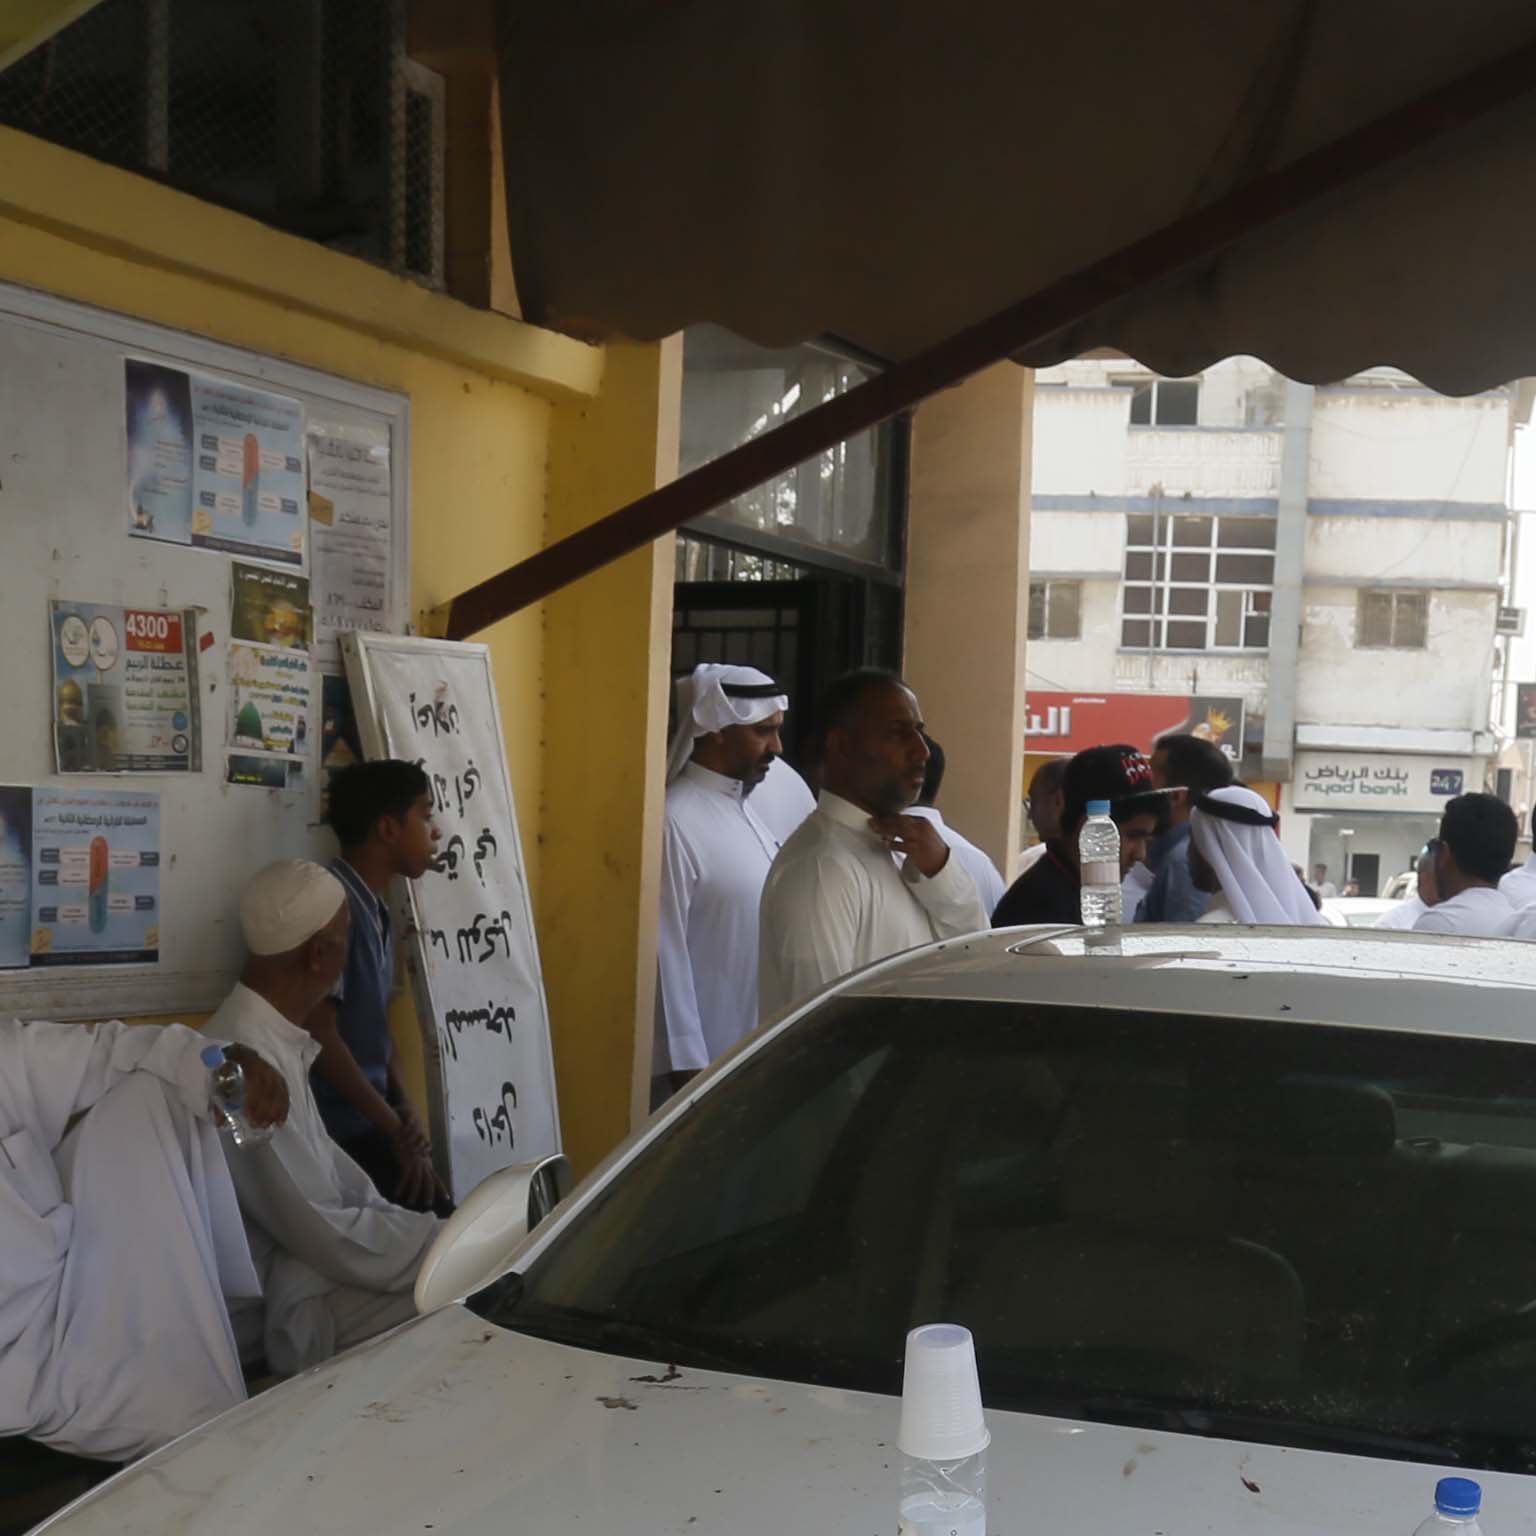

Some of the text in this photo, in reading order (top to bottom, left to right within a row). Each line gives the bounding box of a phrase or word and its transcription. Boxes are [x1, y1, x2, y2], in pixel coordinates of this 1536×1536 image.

[126, 613, 169, 639] 4300
[1304, 764, 1409, 783] بنك الرياض
[1359, 779, 1409, 797] bank
[473, 826, 498, 889] في
[442, 1000, 516, 1061] المسجد
[472, 1081, 517, 1150] داخل
